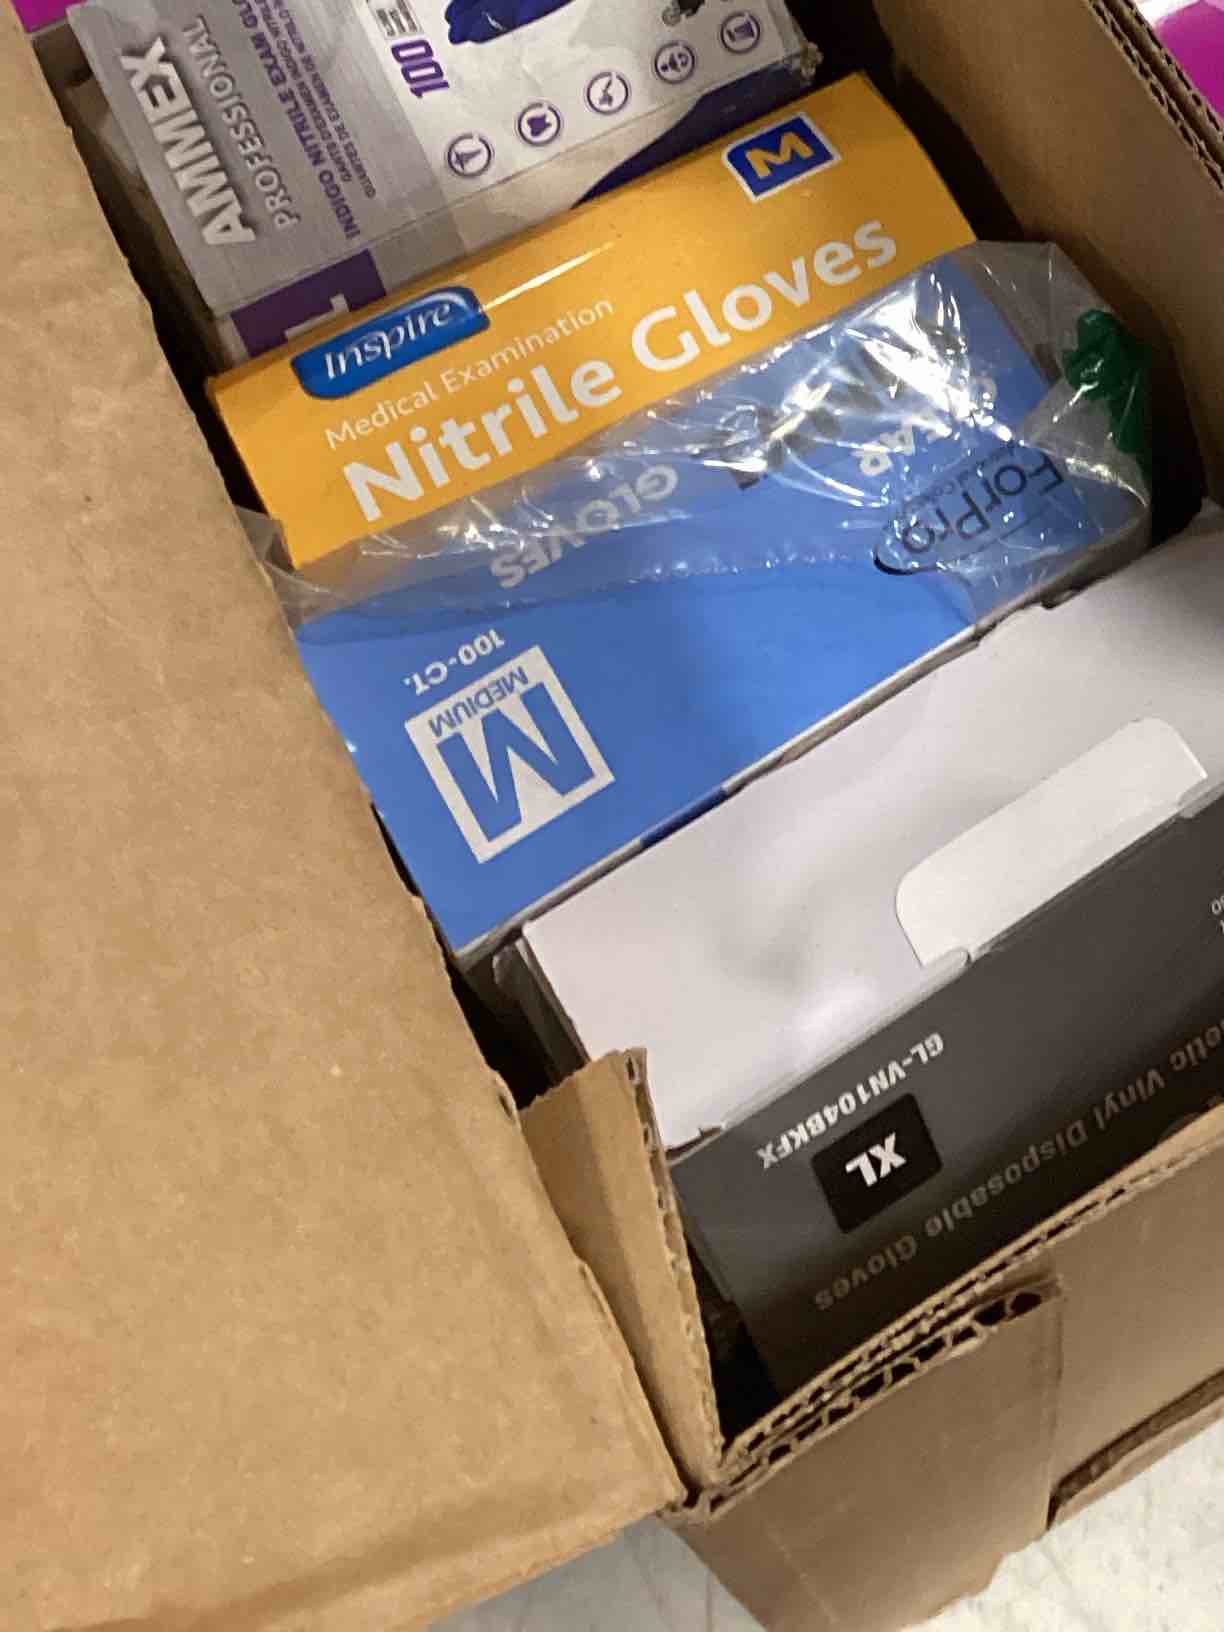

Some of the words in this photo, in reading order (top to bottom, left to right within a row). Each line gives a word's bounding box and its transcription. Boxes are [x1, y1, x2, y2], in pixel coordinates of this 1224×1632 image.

[250, 31, 288, 87] EXAM
[391, 38, 450, 99] 100
[120, 35, 257, 246] AMMEX
[182, 13, 301, 229] PROFESSIONAL
[277, 87, 327, 167] NITRILE
[750, 130, 814, 178] M
[317, 169, 361, 240] INDIGO
[324, 303, 452, 380] Inspire
[324, 381, 439, 450] Medical
[440, 298, 615, 395] Examination
[343, 358, 623, 523] Nitrile
[631, 217, 897, 373] Gloves
[490, 464, 680, 589] GLOVES
[902, 451, 1066, 553] ForPro
[428, 664, 530, 739] MEDIUM
[436, 680, 596, 843] M
[755, 1030, 946, 1170] GL-VN104BKFX
[1094, 1068, 1167, 1130] Vinyl
[845, 1131, 907, 1188] XL
[923, 1119, 1090, 1238] Disposable
[813, 1233, 920, 1311] Gloves
